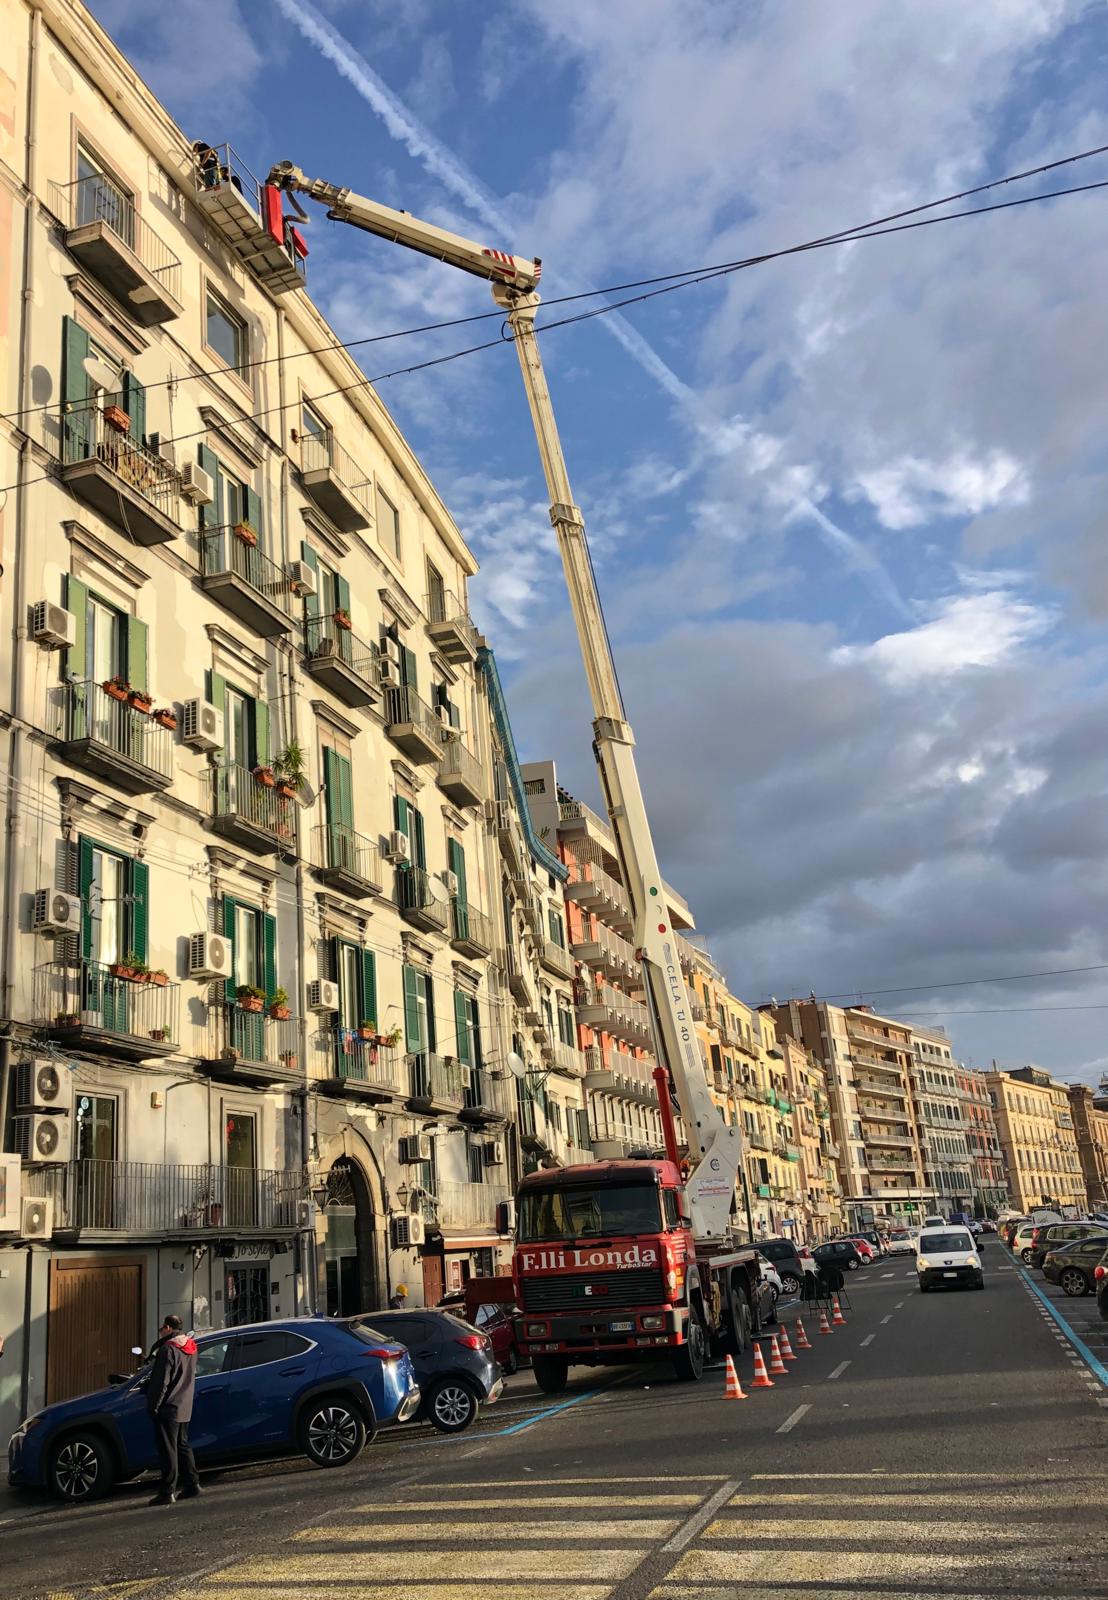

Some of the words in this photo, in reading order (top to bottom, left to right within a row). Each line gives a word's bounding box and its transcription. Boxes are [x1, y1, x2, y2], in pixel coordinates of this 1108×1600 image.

[676, 1009, 686, 1021] TJ
[680, 1026, 690, 1041] 40
[522, 1250, 567, 1271] F.lli
[573, 1245, 657, 1267] Londa
[616, 1261, 653, 1270] TurboStar
